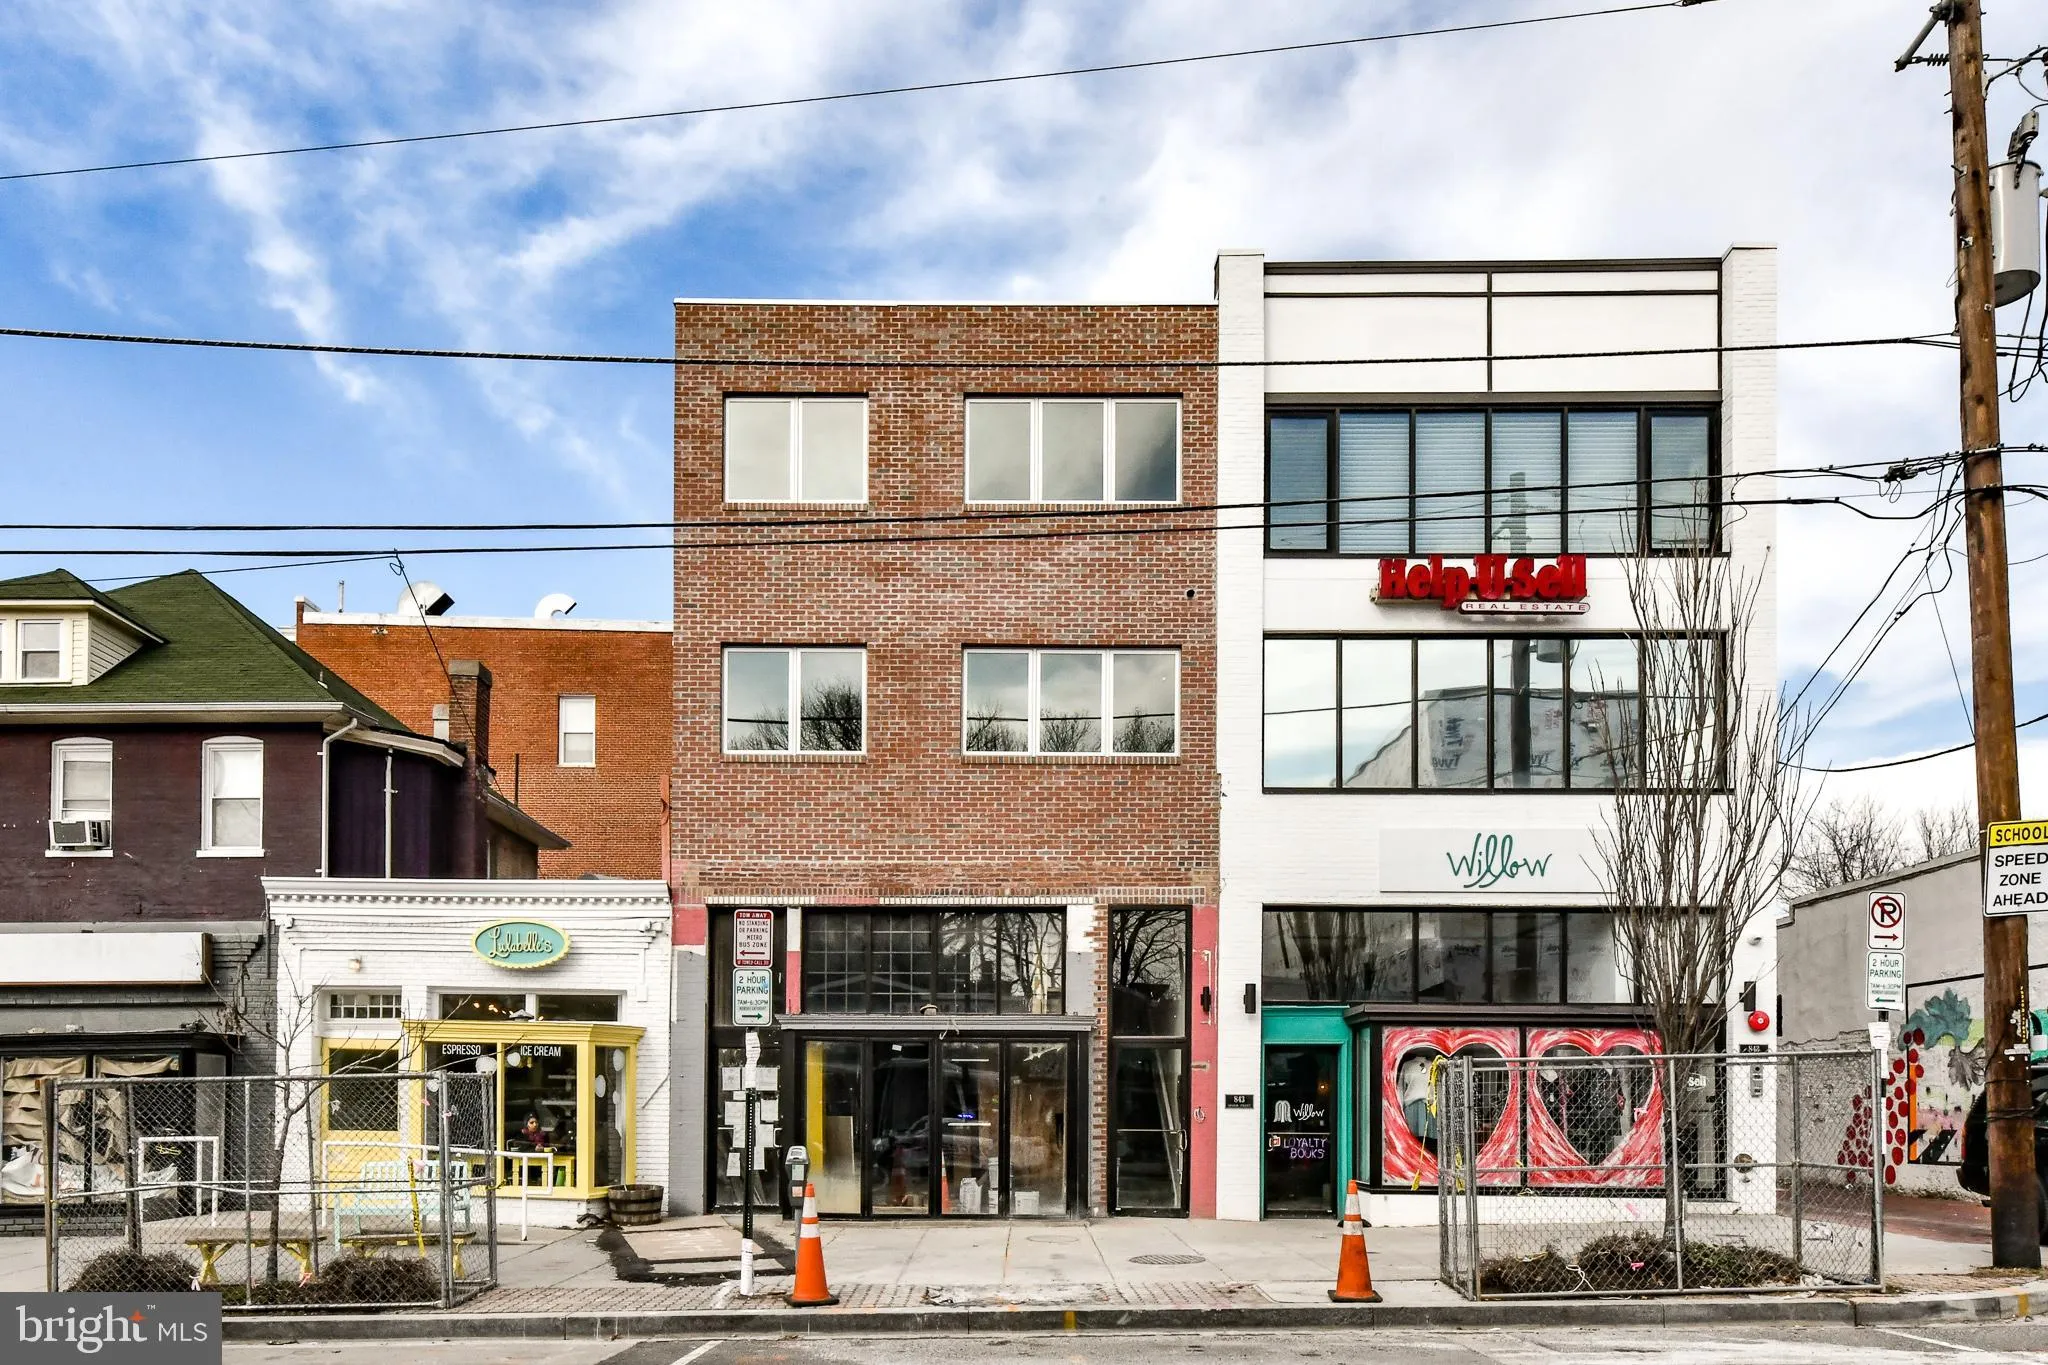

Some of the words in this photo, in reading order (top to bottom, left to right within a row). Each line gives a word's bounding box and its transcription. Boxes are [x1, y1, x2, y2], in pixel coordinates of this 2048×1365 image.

[1465, 602, 1510, 611] REAL
[1519, 602, 1587, 612] ESTATE
[1995, 825, 2048, 843] SCHOOL
[1446, 832, 1553, 889] Willow
[1994, 852, 2048, 868] SPEED
[1999, 872, 2042, 887] ZONE
[1992, 891, 2048, 907] AHEAD
[488, 926, 553, 958] Lulabelle's
[1872, 958, 1877, 967] 2
[1880, 959, 1900, 968] HOUR
[738, 976, 744, 984] 2
[746, 976, 766, 984] HOUR
[1869, 969, 1902, 979] PARKING
[736, 986, 769, 995] PARKING
[441, 1044, 481, 1056] ESPRESSO
[520, 1045, 532, 1056] ICE
[533, 1046, 562, 1057] CREAM
[1293, 1103, 1325, 1121] Willow
[1283, 1137, 1328, 1149] LOYALTY
[1290, 1147, 1325, 1159] BOOKS
